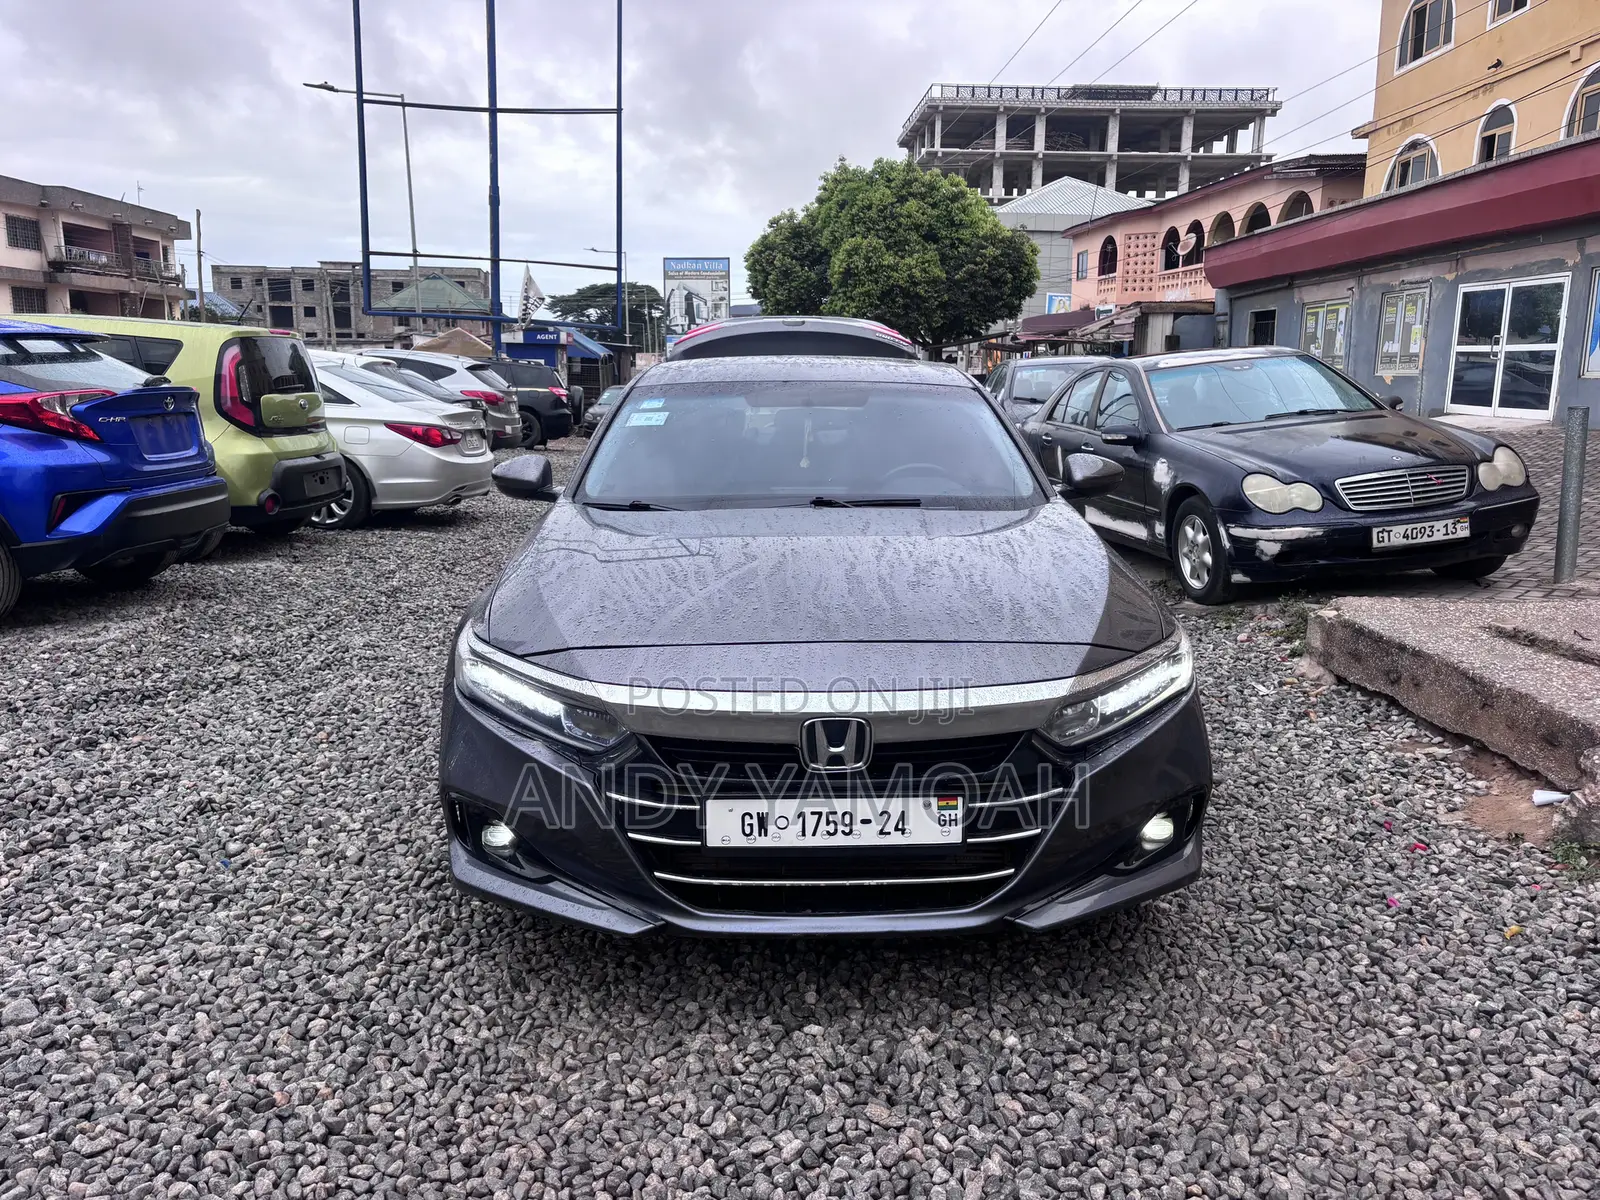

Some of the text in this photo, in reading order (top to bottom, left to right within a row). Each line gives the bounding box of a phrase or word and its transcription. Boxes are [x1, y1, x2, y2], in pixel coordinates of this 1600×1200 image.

[704, 261, 723, 269] Villa
[1459, 523, 1469, 532] GH
[1376, 528, 1393, 543] GT
[741, 811, 769, 838] GW
[796, 810, 907, 837] 1759-24
[937, 813, 958, 827] GH
